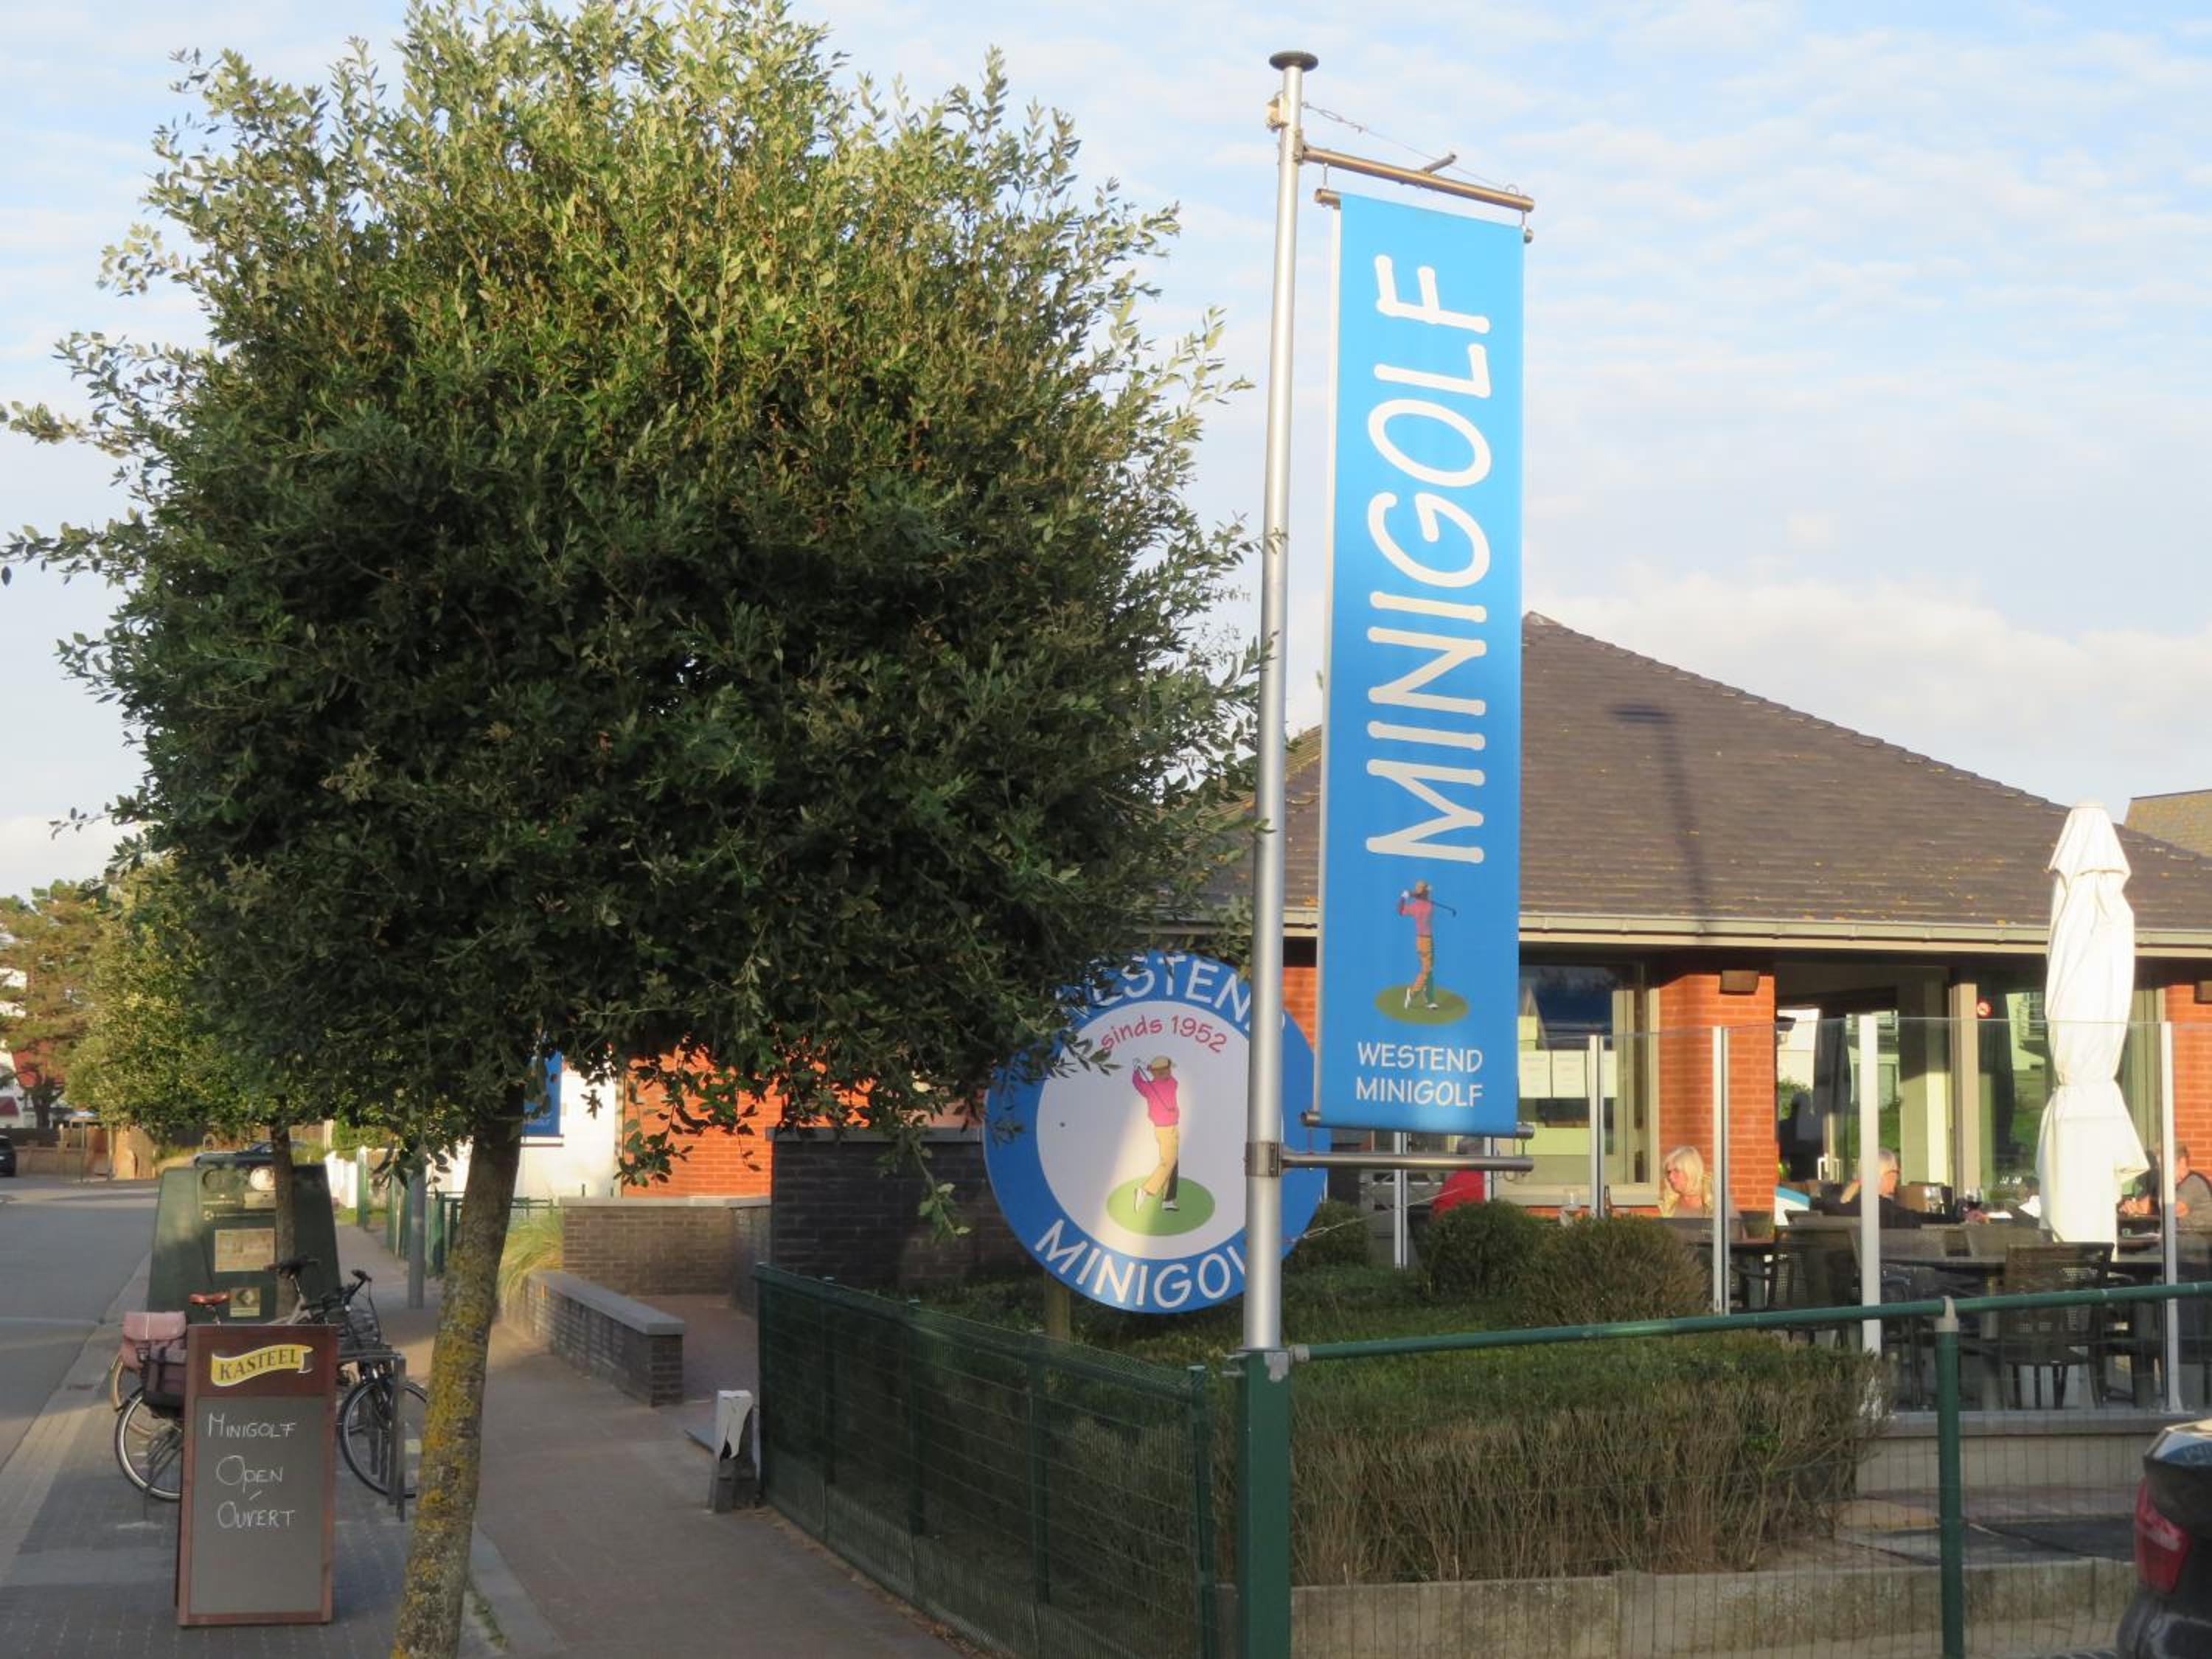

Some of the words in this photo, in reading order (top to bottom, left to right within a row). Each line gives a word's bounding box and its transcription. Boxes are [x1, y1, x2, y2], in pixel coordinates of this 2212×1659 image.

[1366, 254, 1491, 863] MINIGOLF
[1056, 950, 1285, 1032] ESTEN
[1101, 1015, 1164, 1052] sinds
[1171, 1014, 1228, 1054] 1952
[1357, 1041, 1484, 1073] WESTEND
[1356, 1077, 1484, 1107] MINIGOLF
[1035, 1219, 1246, 1309] MINIGO
[220, 1349, 300, 1381] KASTEEL
[208, 1412, 296, 1438] MINIGOLF
[218, 1500, 296, 1528] OUVERT
